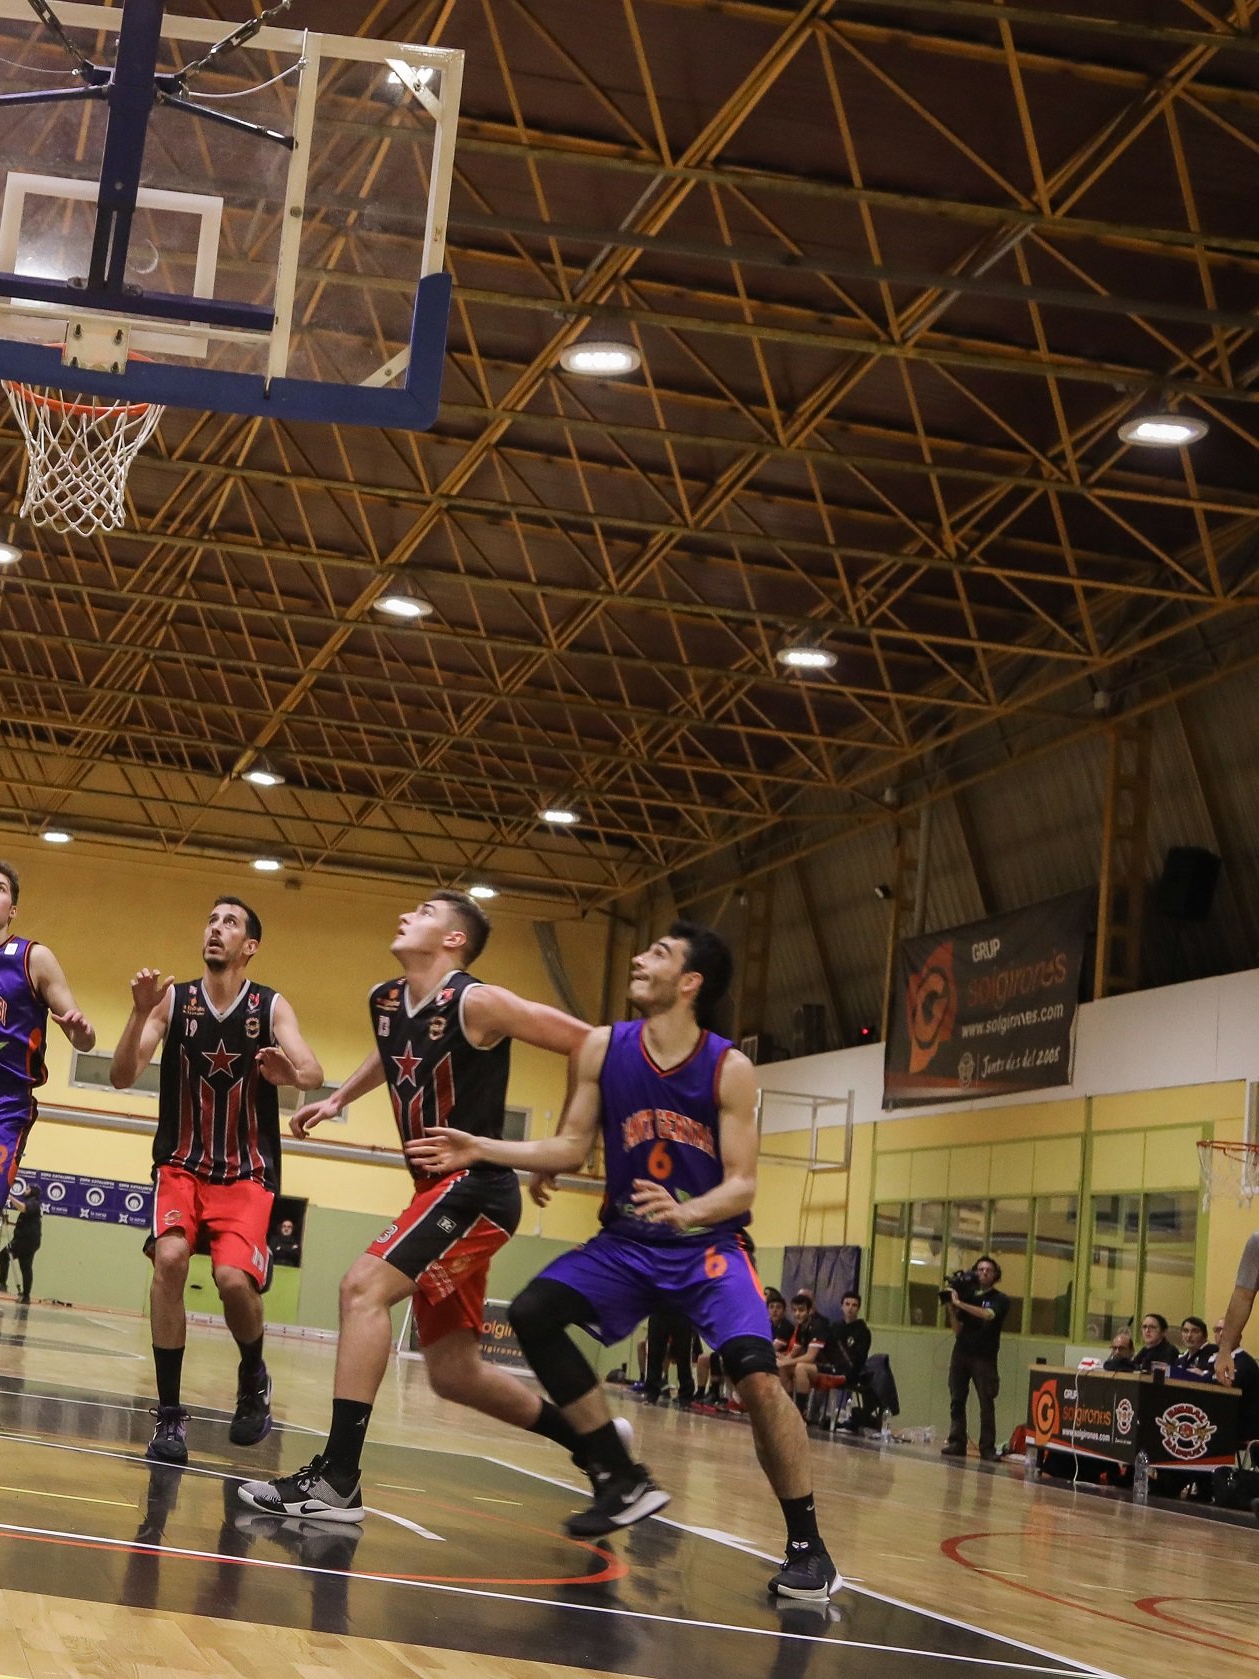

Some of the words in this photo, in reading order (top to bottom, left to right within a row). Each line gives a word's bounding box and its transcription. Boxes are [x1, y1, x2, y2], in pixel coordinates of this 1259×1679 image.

[972, 938, 1001, 962] GRUP
[185, 1018, 198, 1037] 19
[649, 1142, 673, 1180] 6
[704, 1246, 727, 1278] 6
[1063, 1388, 1078, 1400] GRUP
